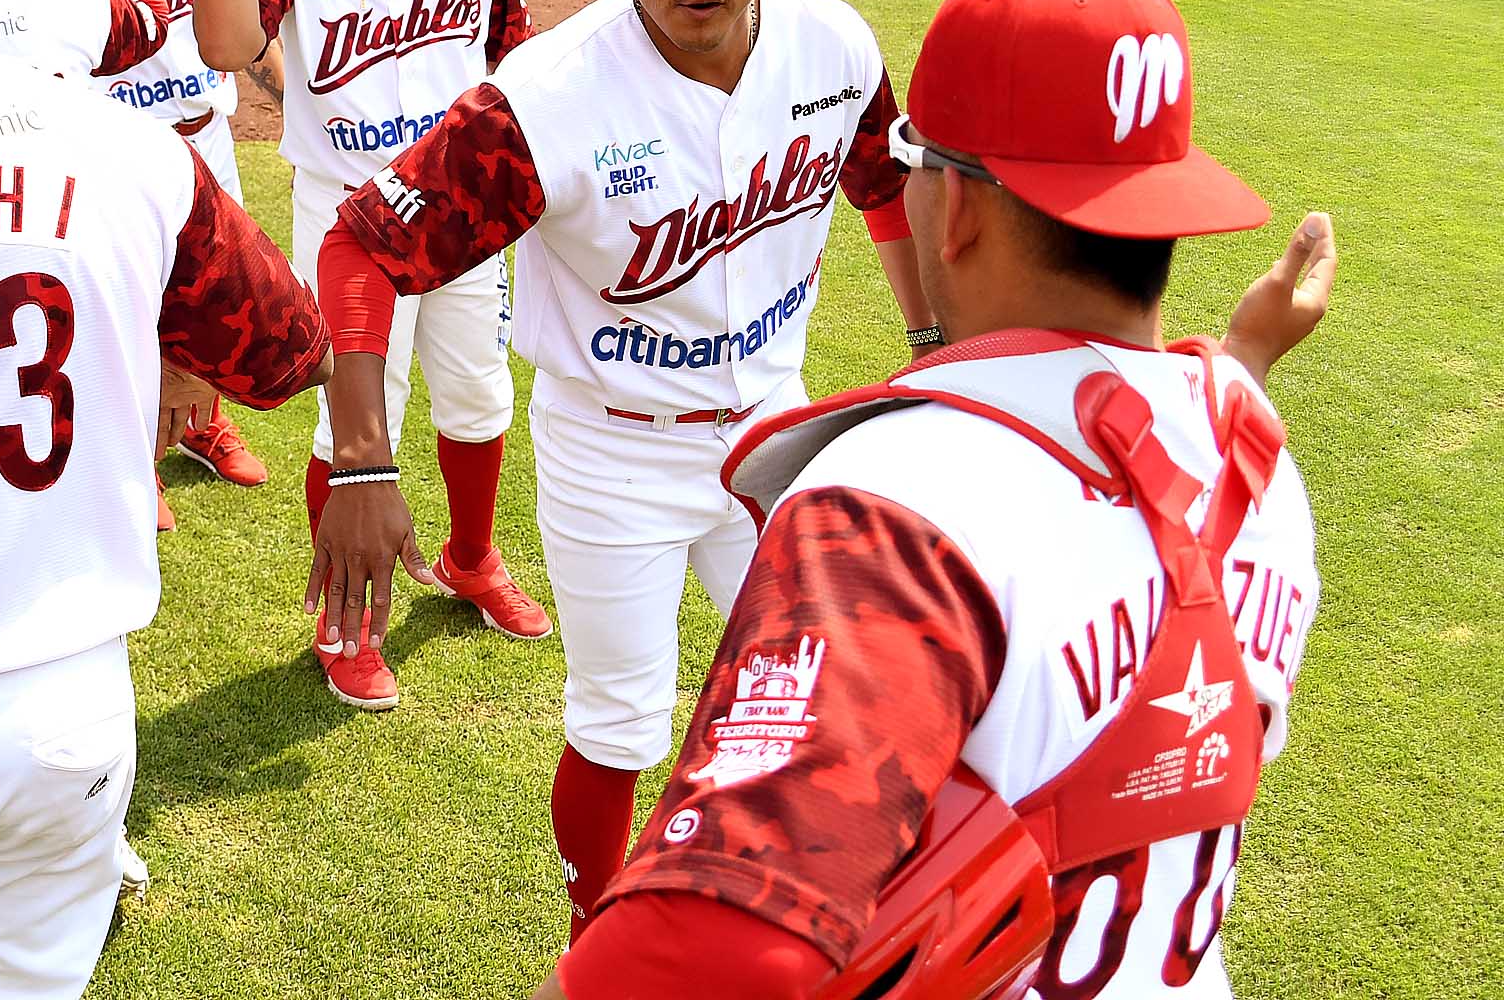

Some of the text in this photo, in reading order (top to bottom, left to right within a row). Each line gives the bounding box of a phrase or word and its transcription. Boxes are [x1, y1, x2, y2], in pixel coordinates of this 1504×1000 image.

[604, 176, 657, 198] LIGHT
[610, 166, 646, 183] BUD
[604, 134, 843, 298] Diablos
[591, 272, 811, 369] citibanamex
